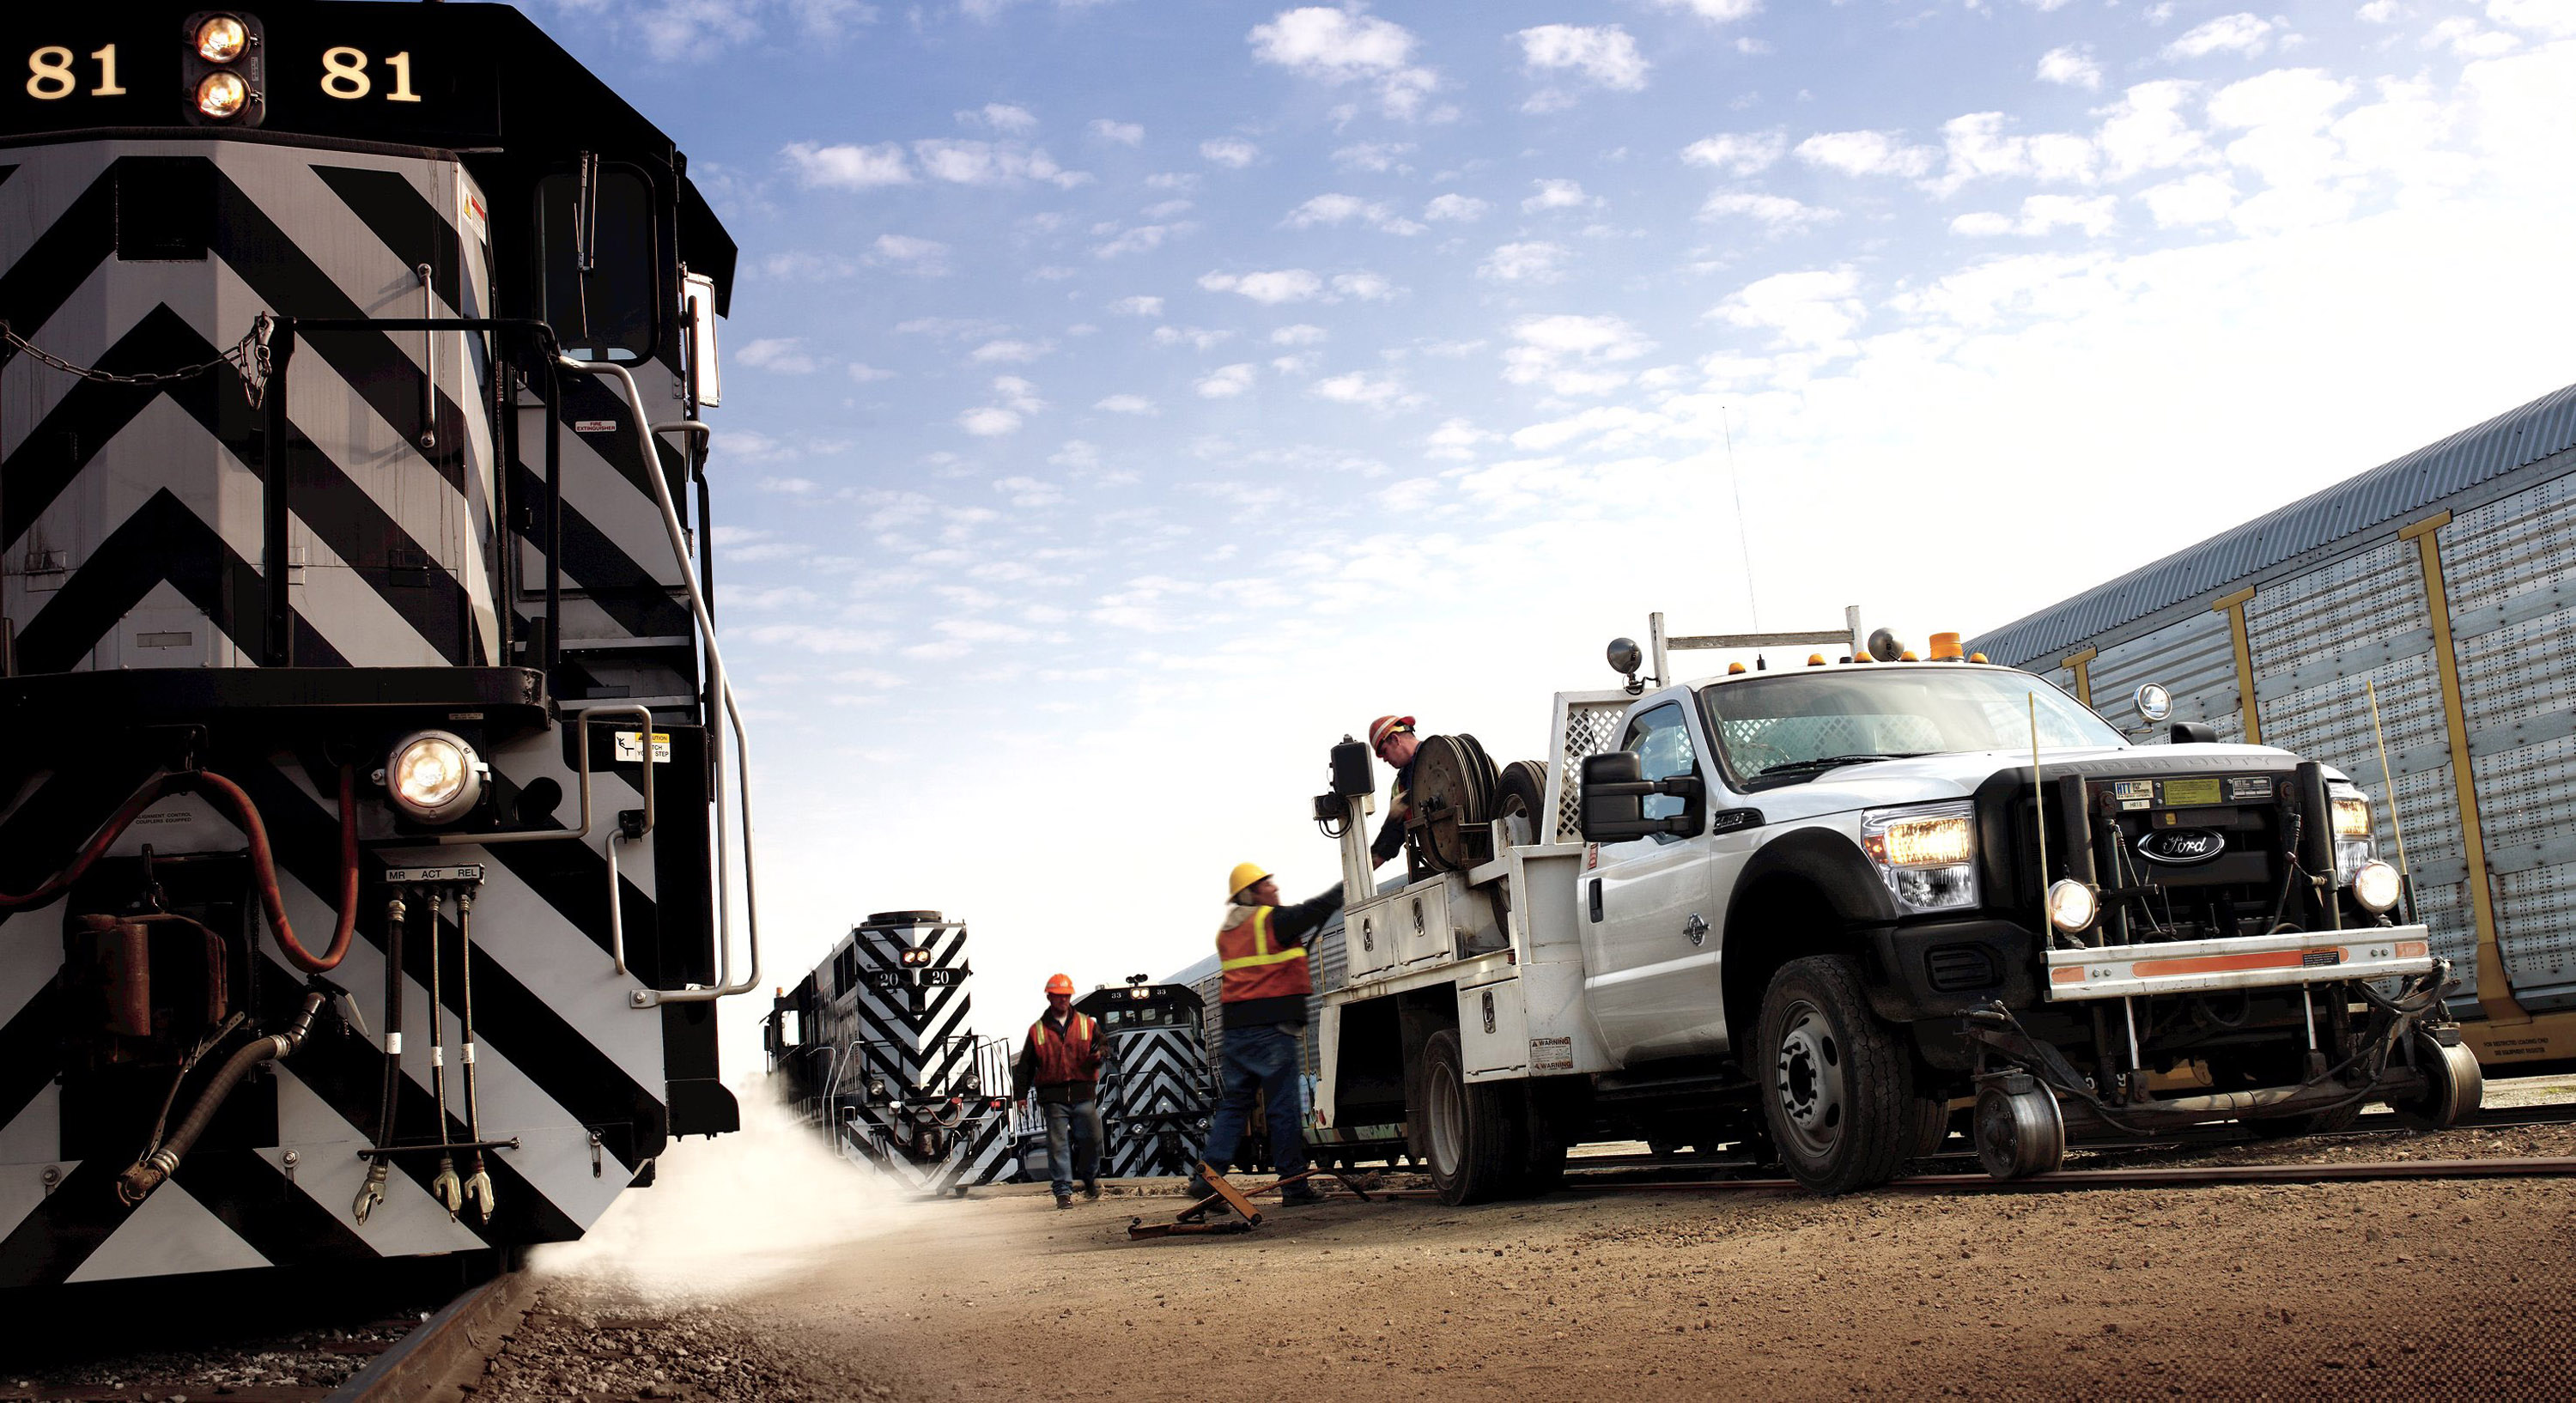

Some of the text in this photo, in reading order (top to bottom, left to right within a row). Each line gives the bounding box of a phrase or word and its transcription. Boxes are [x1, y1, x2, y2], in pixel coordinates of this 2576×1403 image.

[27, 44, 126, 100] 81
[320, 46, 421, 102] 81
[2047, 756, 2271, 774] SUPER DUTY
[2163, 832, 2207, 854] Ford
[389, 868, 477, 880] MR ACT REL
[880, 973, 899, 987] 20
[932, 971, 950, 985] 20
[1539, 1038, 1570, 1047] WARNING
